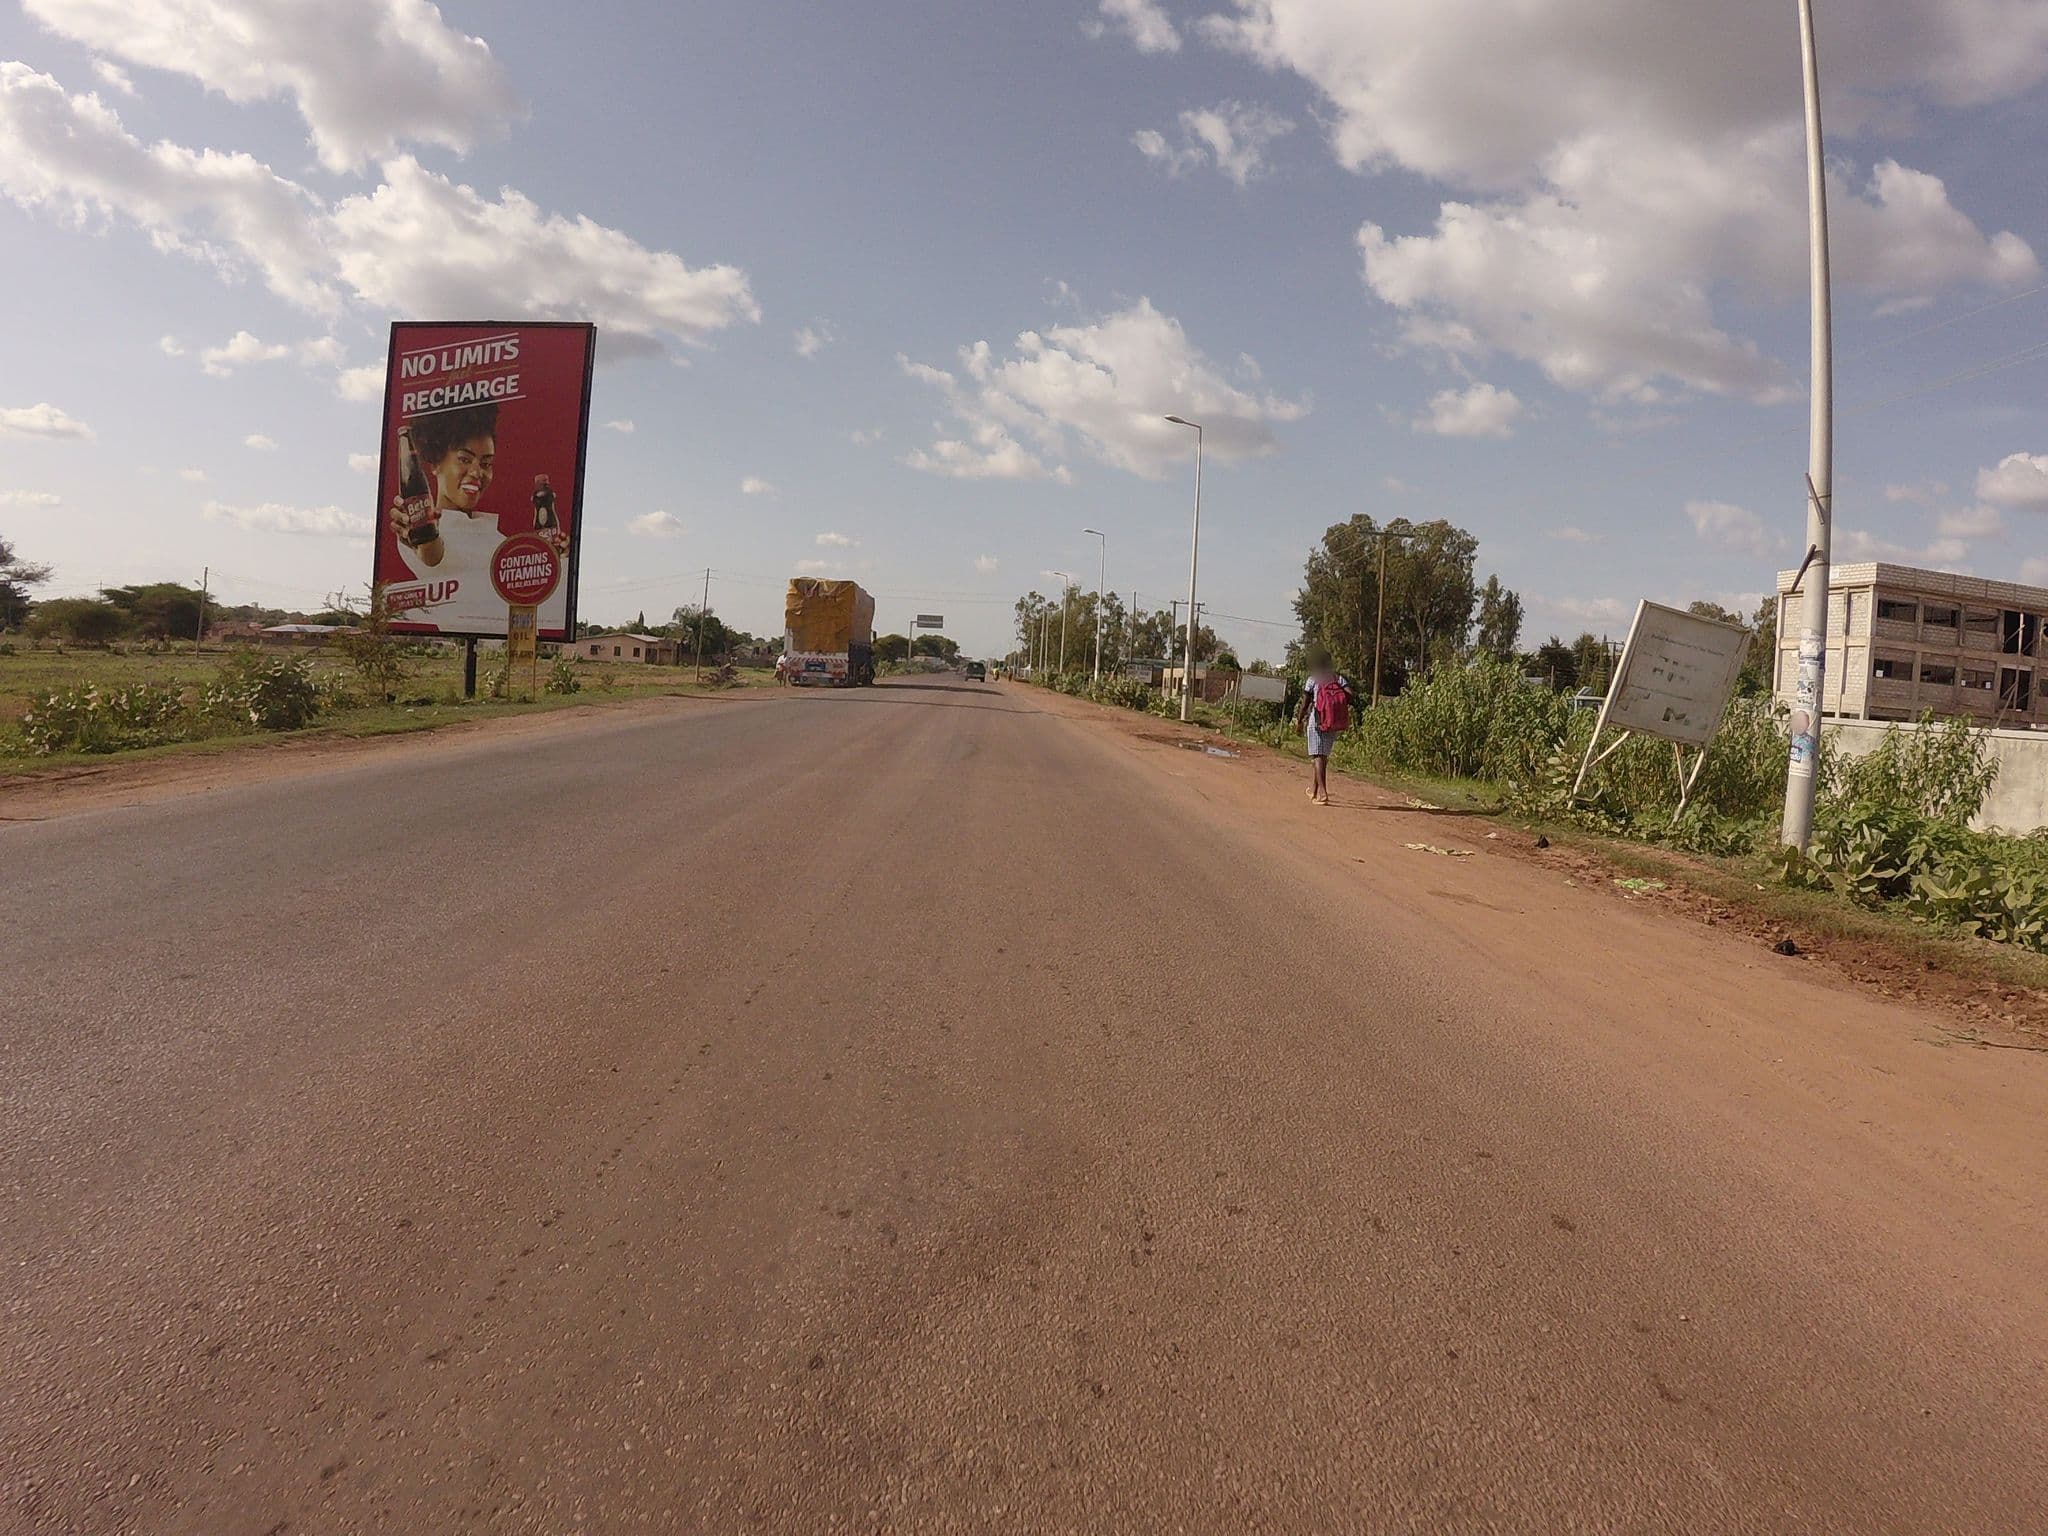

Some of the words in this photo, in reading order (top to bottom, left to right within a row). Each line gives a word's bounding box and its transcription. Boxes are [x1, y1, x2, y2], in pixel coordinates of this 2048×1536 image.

[401, 354, 436, 378] NO
[441, 339, 520, 371] LIMITS
[402, 374, 520, 412] RECHARGE
[408, 498, 432, 515] Beta
[500, 552, 548, 569] CONTAINS
[499, 563, 552, 583] VITAMINS
[428, 580, 459, 602] UP
[513, 631, 530, 640] OIL
